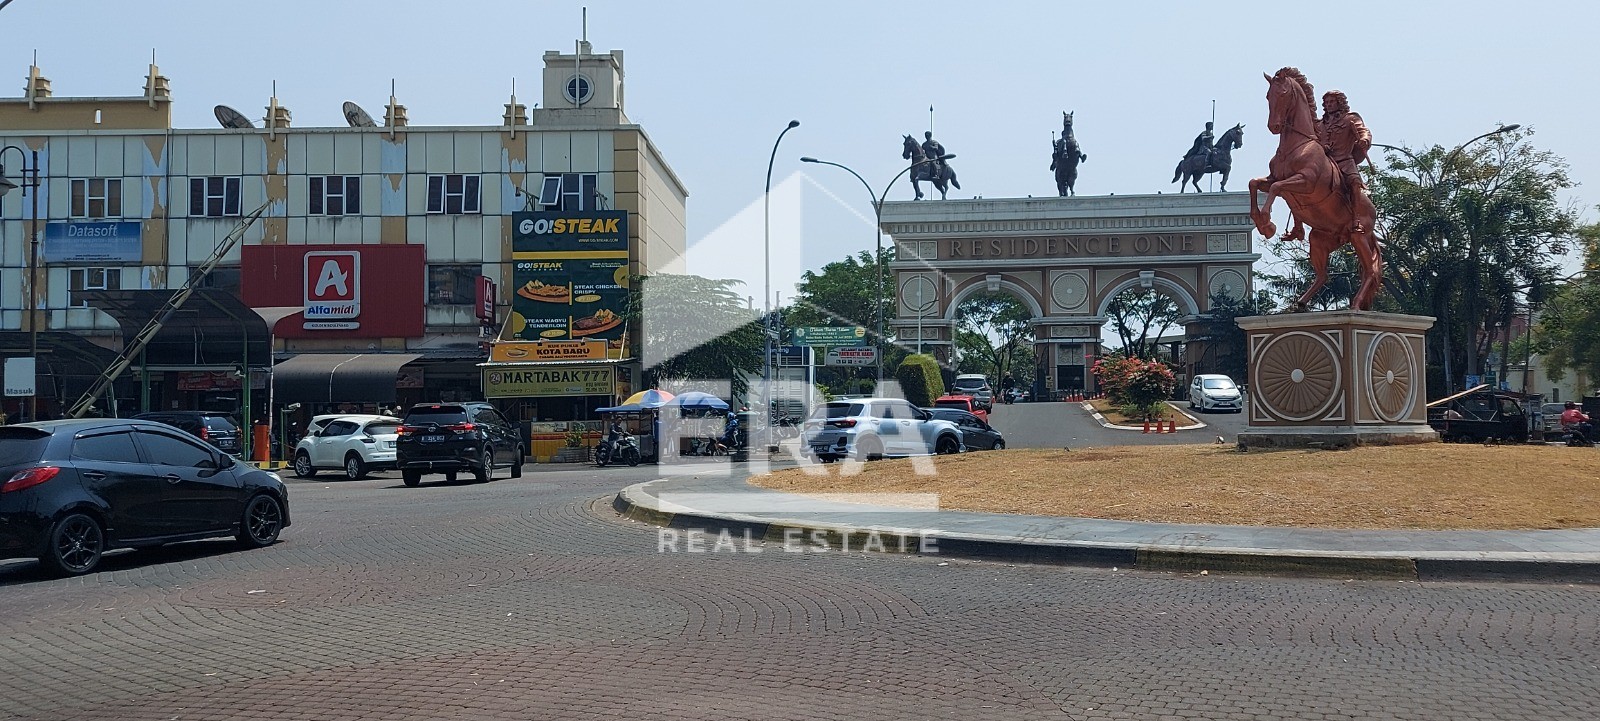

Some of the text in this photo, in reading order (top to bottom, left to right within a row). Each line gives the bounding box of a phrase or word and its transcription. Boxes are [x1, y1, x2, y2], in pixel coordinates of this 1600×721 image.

[68, 224, 118, 237] Datasoft
[519, 218, 620, 235] GO!STEAK
[950, 234, 1195, 256] RESIDENCE ONE
[307, 304, 355, 315] Alfamidi
[503, 370, 581, 383] MARTABAK
[581, 370, 610, 381] 777
